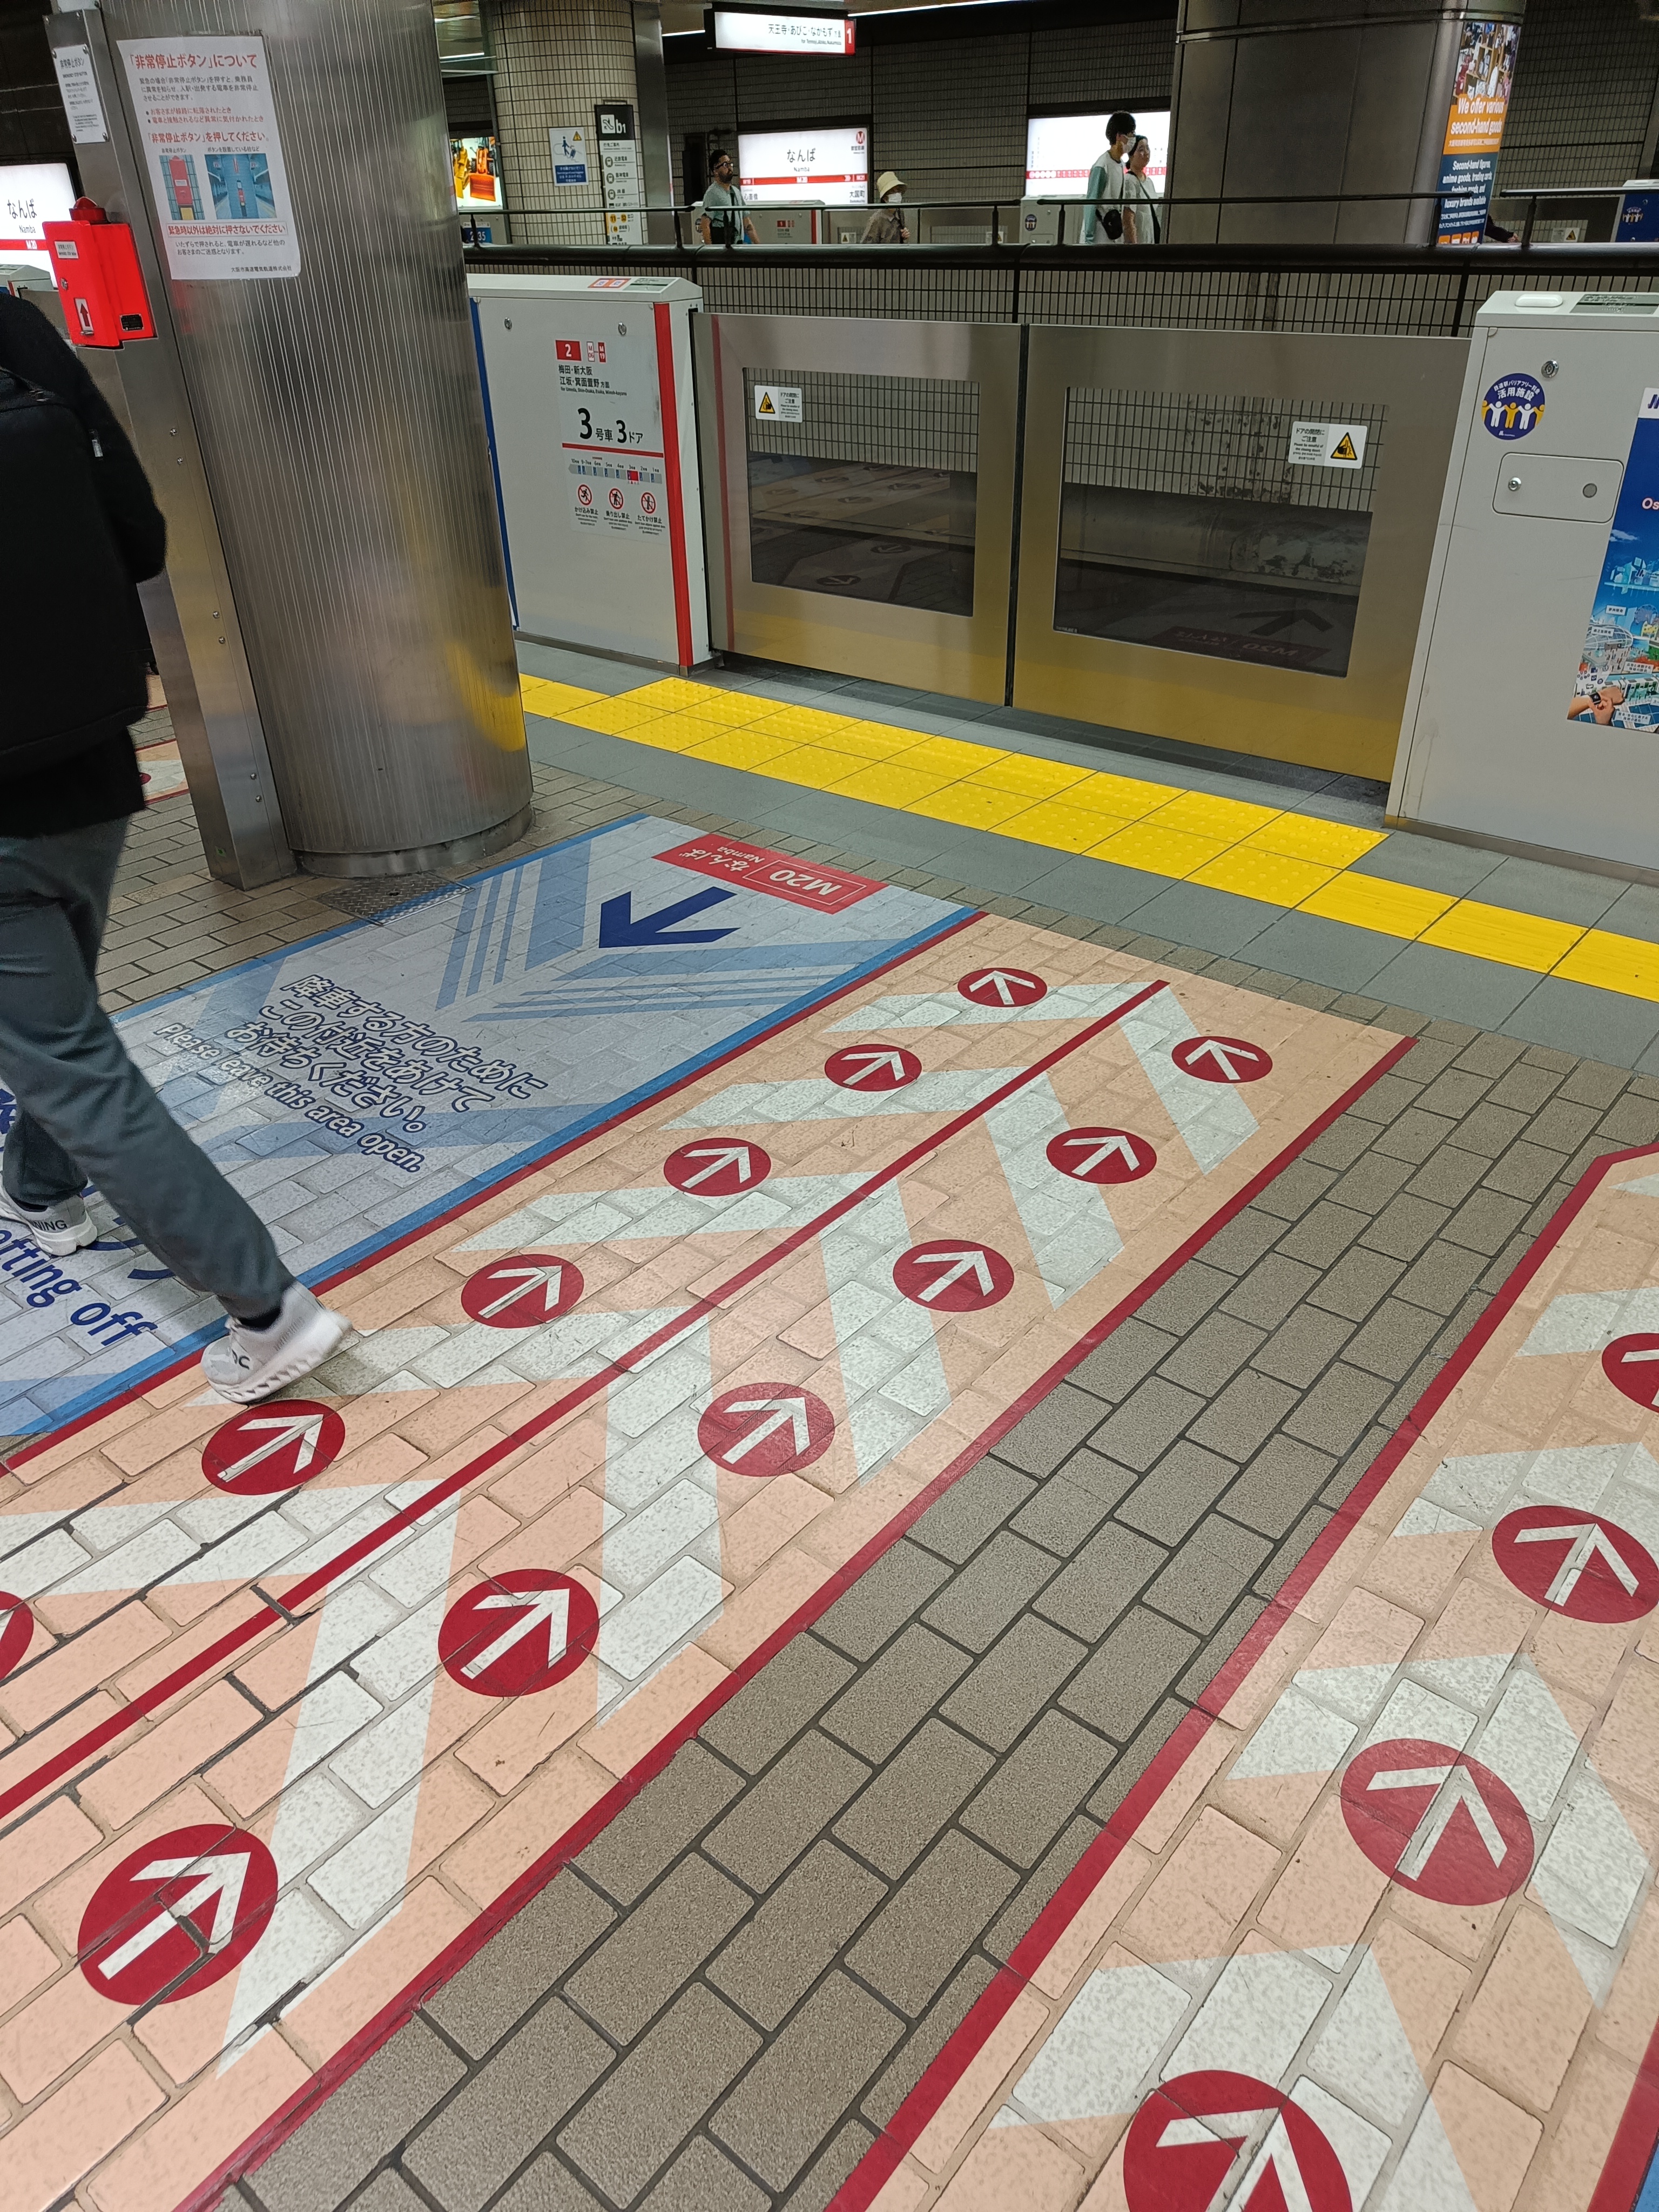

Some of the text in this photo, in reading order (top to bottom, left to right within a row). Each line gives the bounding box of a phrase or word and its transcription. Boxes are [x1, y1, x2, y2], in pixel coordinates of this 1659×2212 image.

[847, 28, 852, 44] 1
[130, 54, 257, 70] 「非常停止ボタン」について
[1458, 97, 1505, 114] We offer various
[616, 119, 626, 133] b1
[1451, 118, 1502, 135] second-hand goods
[148, 131, 269, 143] 「非常停止ボタン」を押してください。
[787, 147, 816, 163] なんば
[1442, 174, 1457, 184] anime
[7, 198, 37, 219] なんば
[19, 225, 36, 233] Namba
[168, 224, 286, 236] 緊急時以外は絶対に押さないでください
[565, 343, 572, 357] 2
[558, 364, 593, 375] 梅田・新大阪
[1498, 387, 1534, 401] 活用施設
[679, 848, 750, 872] なんば
[717, 846, 765, 864] Namba
[769, 869, 842, 896] M20
[279, 974, 549, 1100] 降車する方のために
[259, 999, 496, 1112] この付近をあけて
[224, 1021, 426, 1133] お待ちください。
[153, 1022, 425, 1173] Please leave this area open.
[70, 1302, 158, 1346] off
